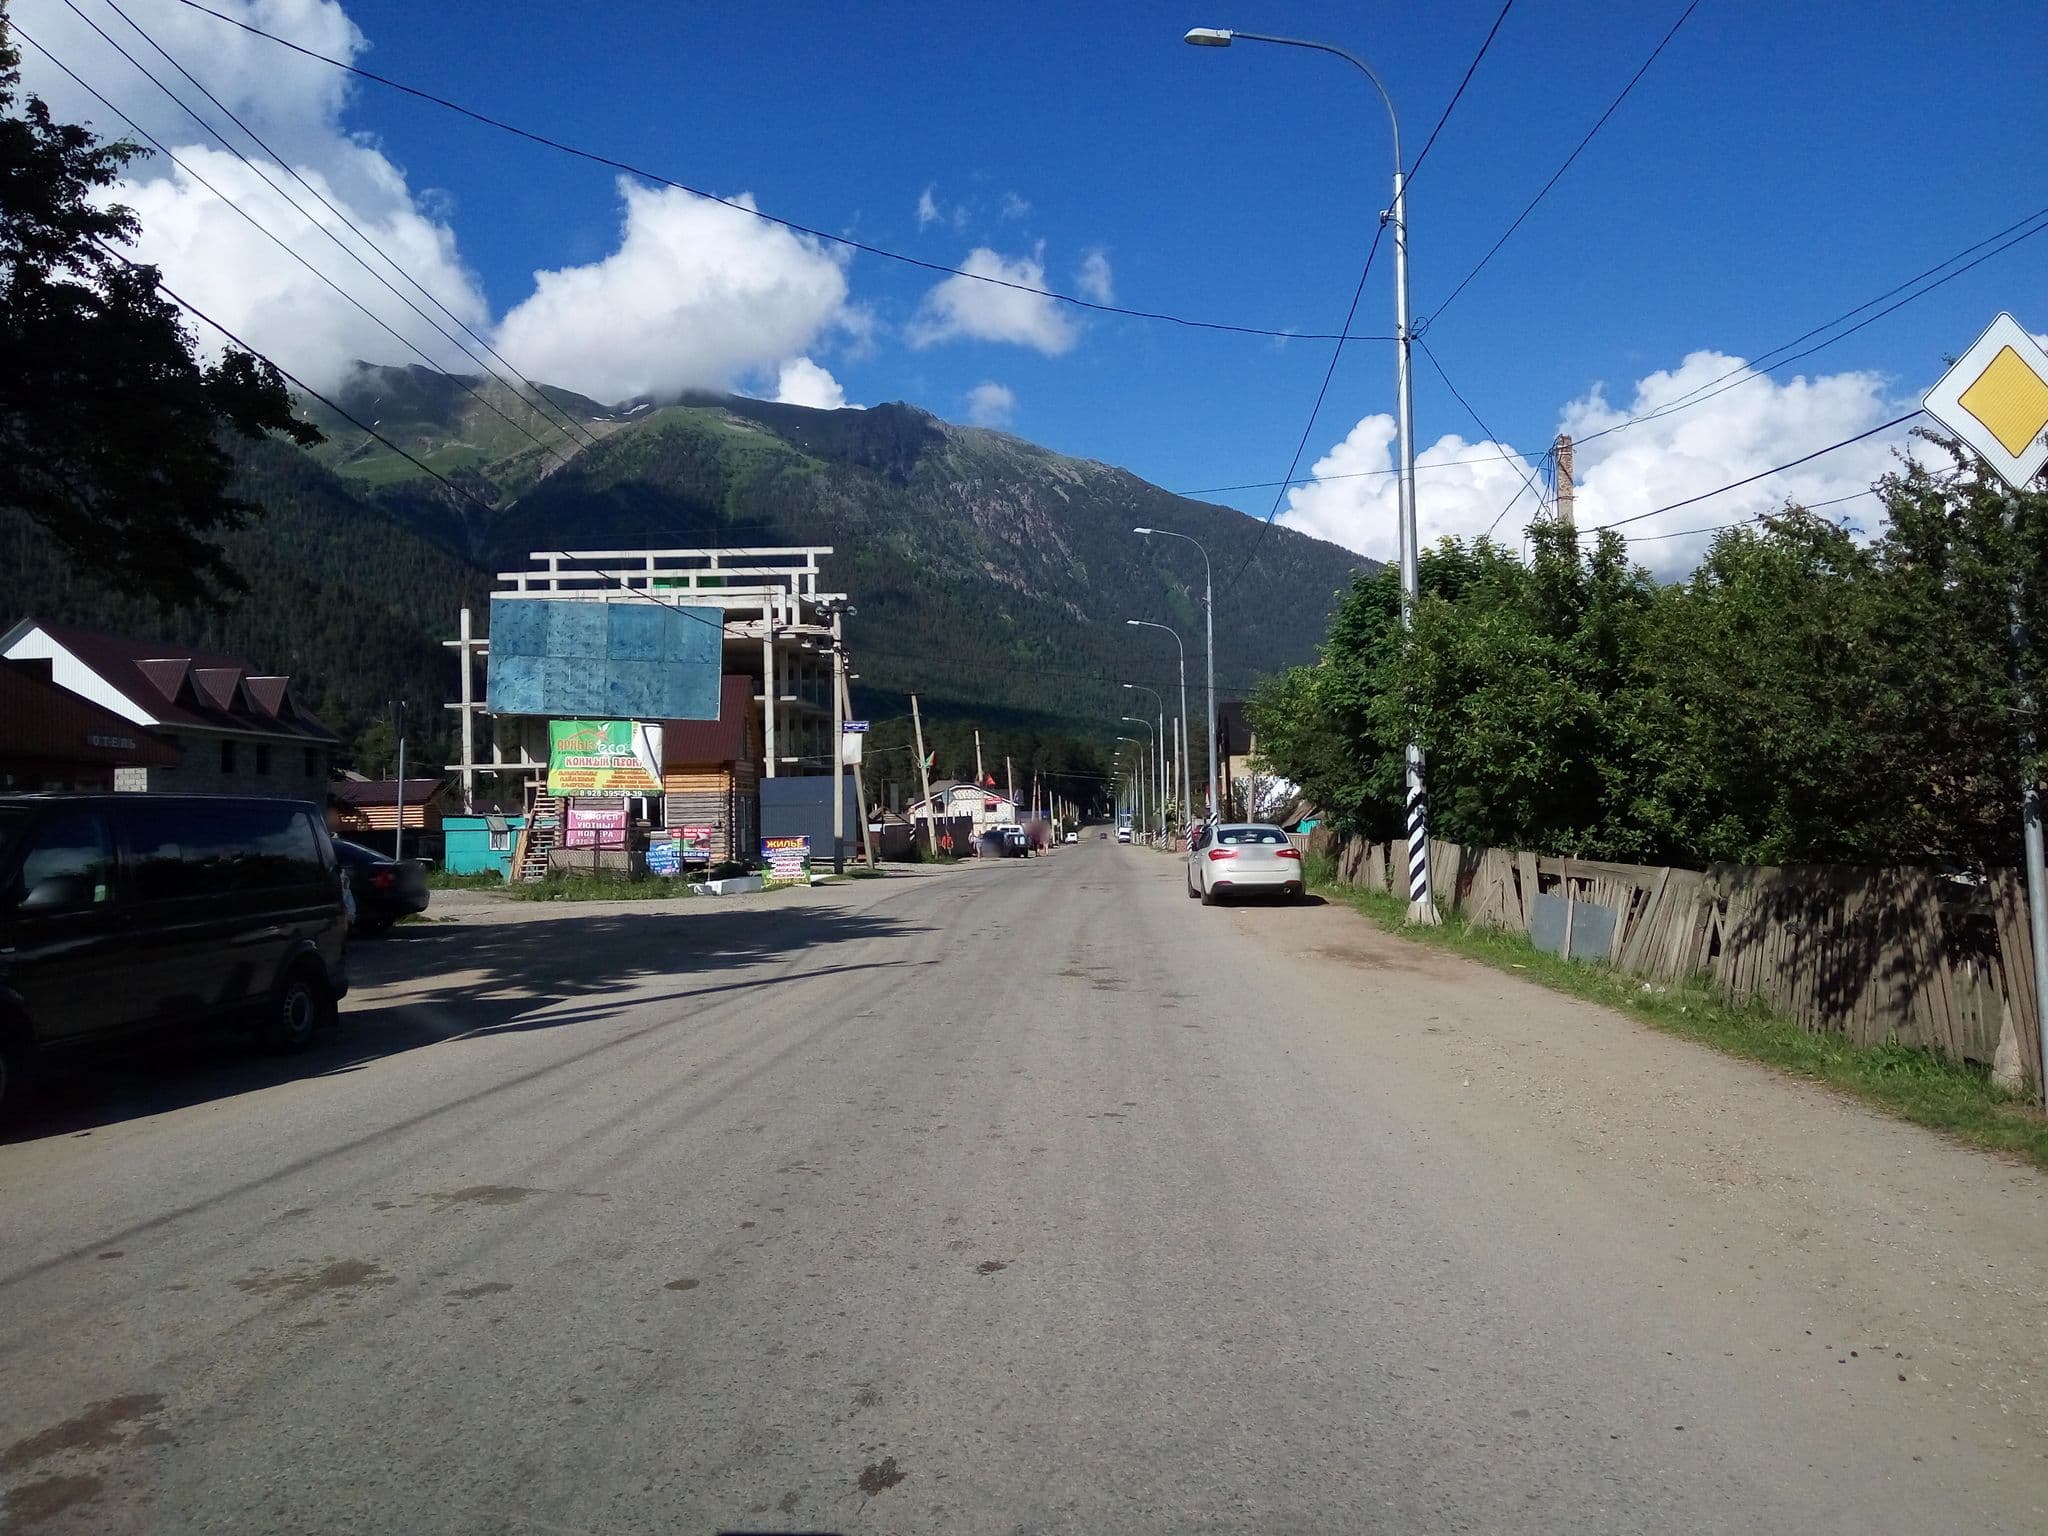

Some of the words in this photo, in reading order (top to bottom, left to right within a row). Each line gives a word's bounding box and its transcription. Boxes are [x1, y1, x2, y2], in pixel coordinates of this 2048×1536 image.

[598, 743, 626, 753] eco
[566, 756, 609, 767] КОННЫЙ
[614, 757, 642, 767] ПРОК
